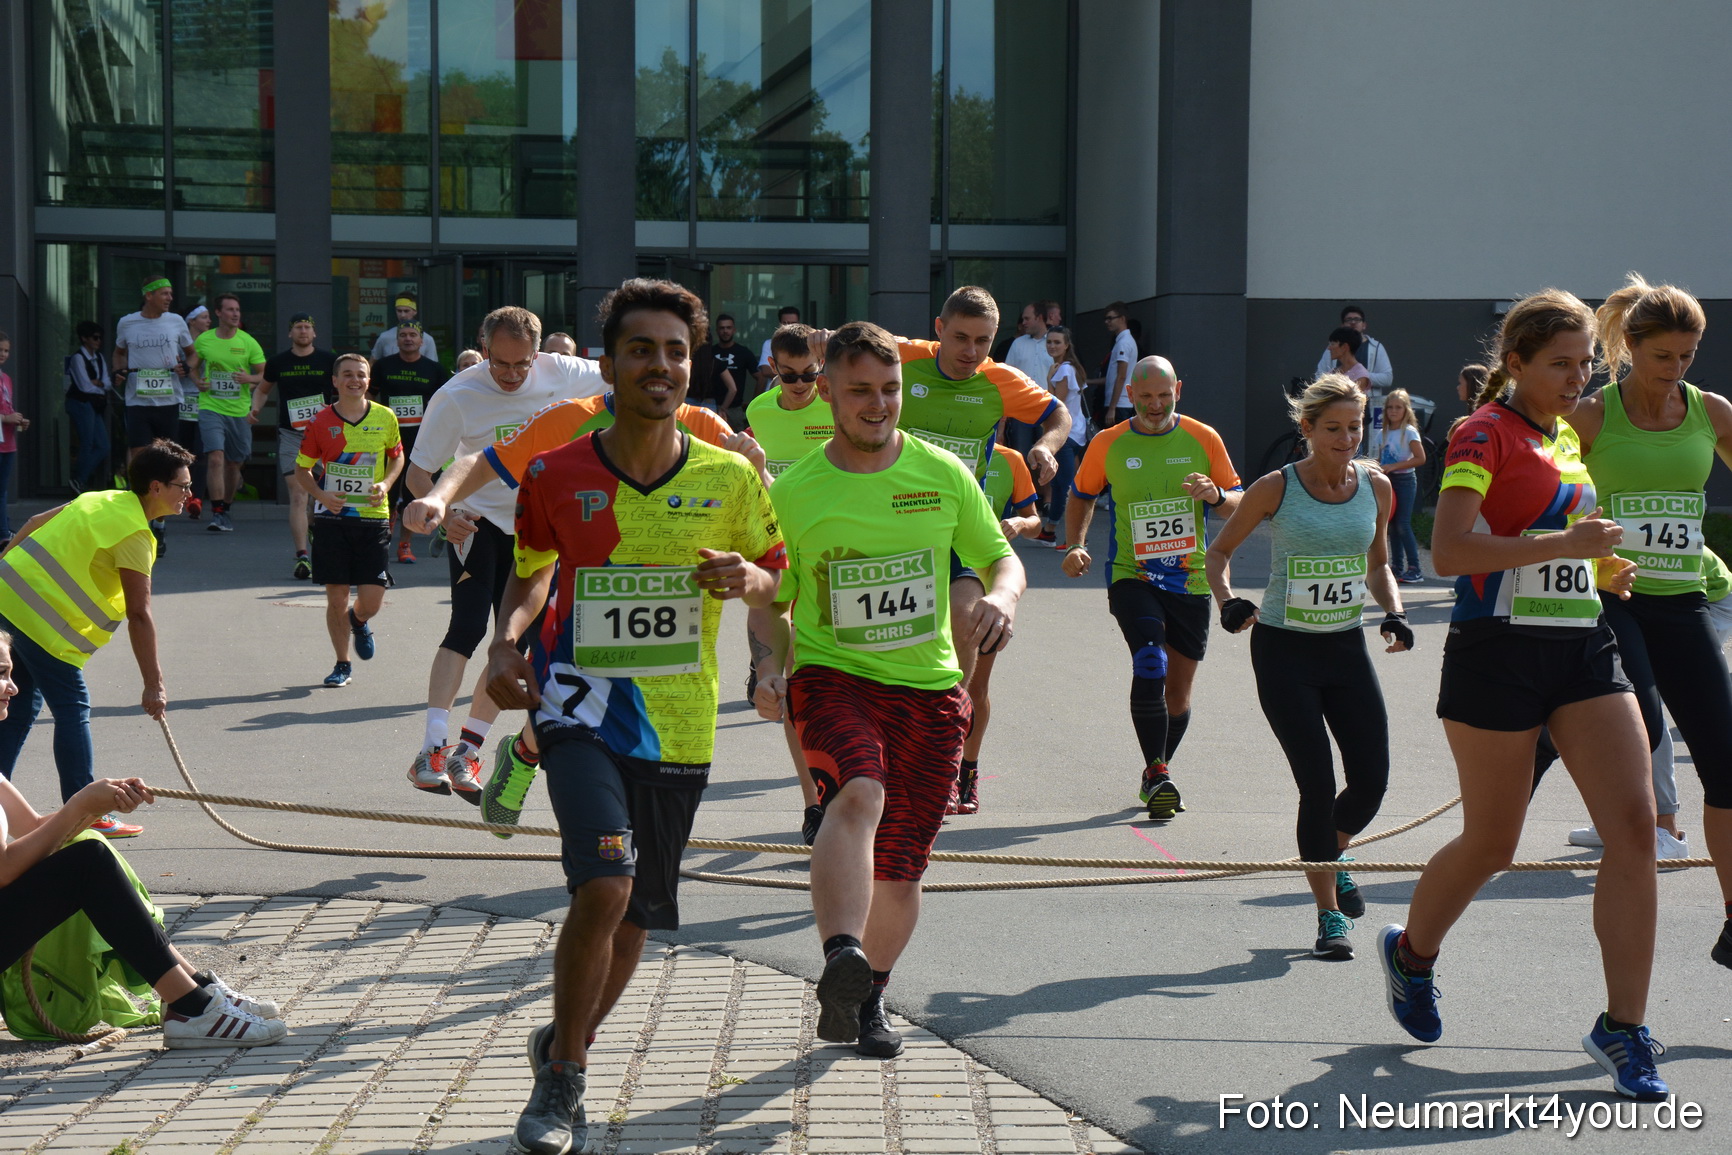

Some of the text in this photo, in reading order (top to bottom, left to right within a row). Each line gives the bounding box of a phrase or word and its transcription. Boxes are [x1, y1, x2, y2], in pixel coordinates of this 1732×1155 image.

[360, 289, 387, 297] REWE
[366, 313, 383, 322] dm
[145, 379, 164, 388] 107
[216, 381, 234, 390] 134
[290, 399, 321, 408] BOCK
[955, 395, 983, 404] BOCK
[395, 407, 416, 416] 536
[329, 465, 370, 477] BOCK
[335, 479, 363, 493] 162
[893, 491, 939, 500] NEUMARKTER
[892, 498, 941, 508] ELEMENTELAUF
[1134, 500, 1189, 518] BOCK
[1620, 496, 1699, 516] BOCK
[1146, 518, 1184, 539] 526
[1639, 523, 1690, 549] 143
[1145, 540, 1187, 552] MARKUS
[1294, 557, 1362, 576] BOCK
[1637, 555, 1683, 569] SONJA
[838, 554, 927, 586] BOCK
[584, 571, 692, 596] BOCK
[1538, 564, 1589, 593] 180
[1308, 581, 1353, 605] 145
[857, 587, 917, 620] 144
[1529, 601, 1564, 615] RONJA
[604, 606, 676, 639] 168
[1302, 610, 1353, 623] YVONNE
[864, 624, 913, 641] CHRIS
[590, 650, 636, 664] BASHIR
